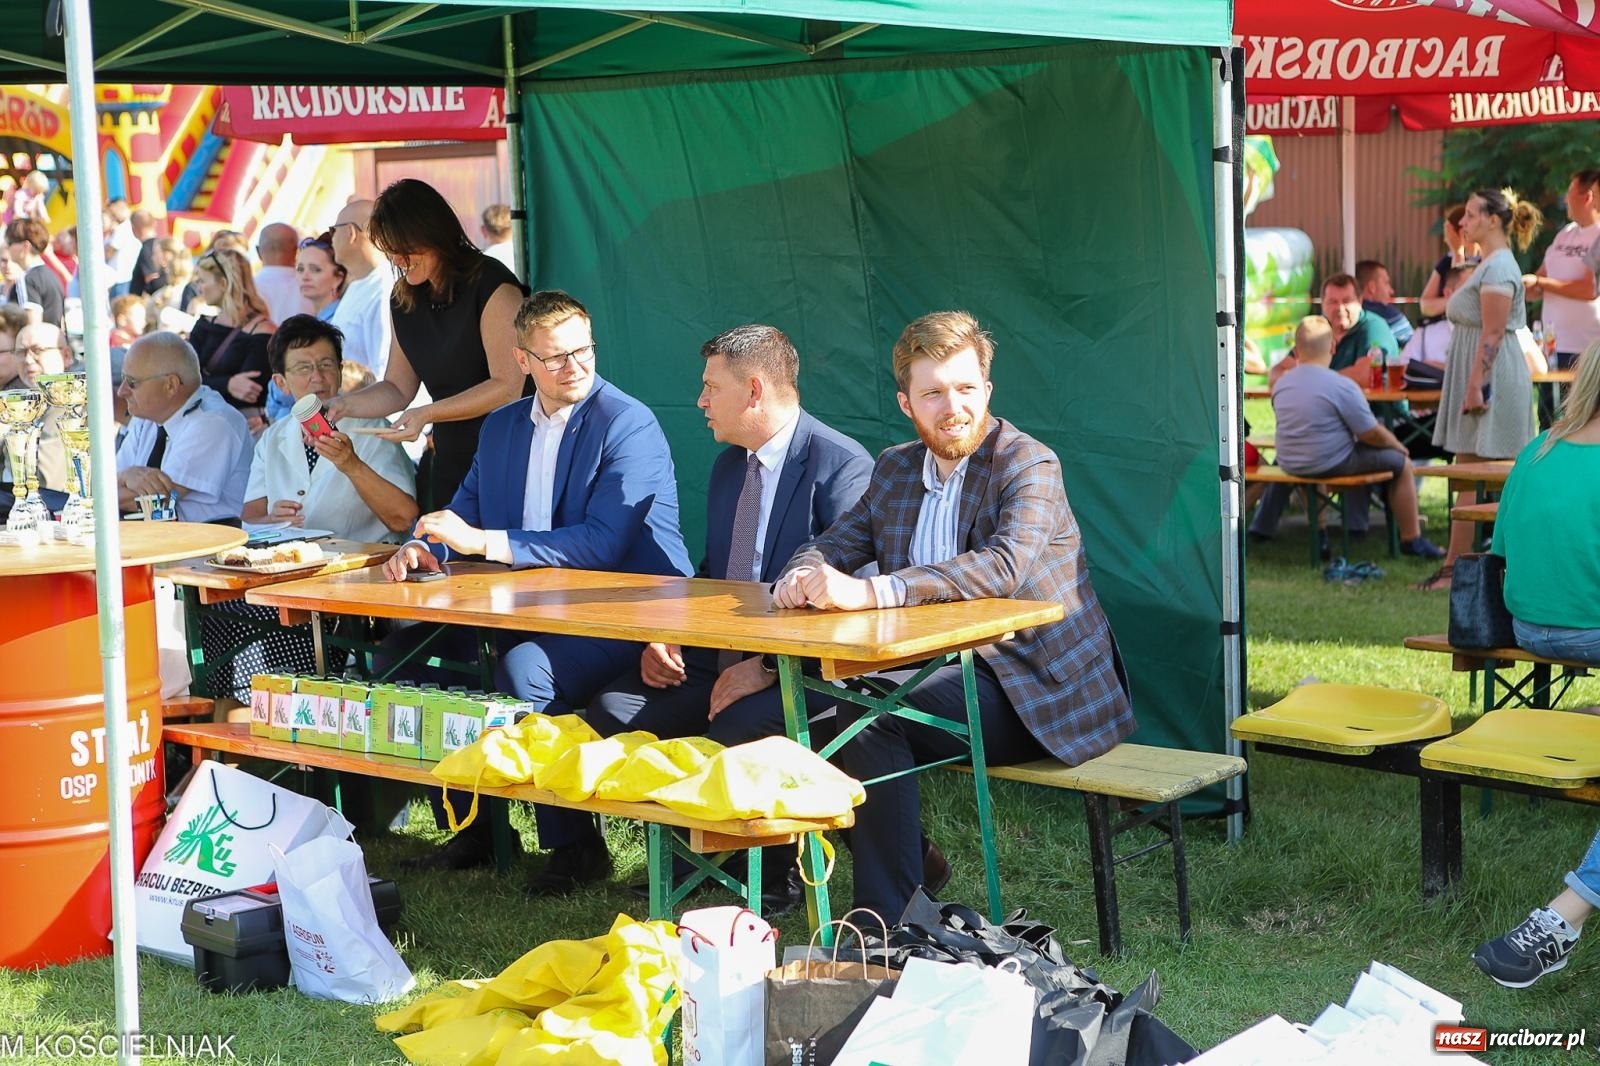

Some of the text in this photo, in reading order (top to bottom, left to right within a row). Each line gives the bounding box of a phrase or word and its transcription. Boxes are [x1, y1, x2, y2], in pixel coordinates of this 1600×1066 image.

[251, 86, 465, 120] RACIBORSKIE
[70, 709, 151, 767] STAŻ
[60, 773, 98, 800] OSP
